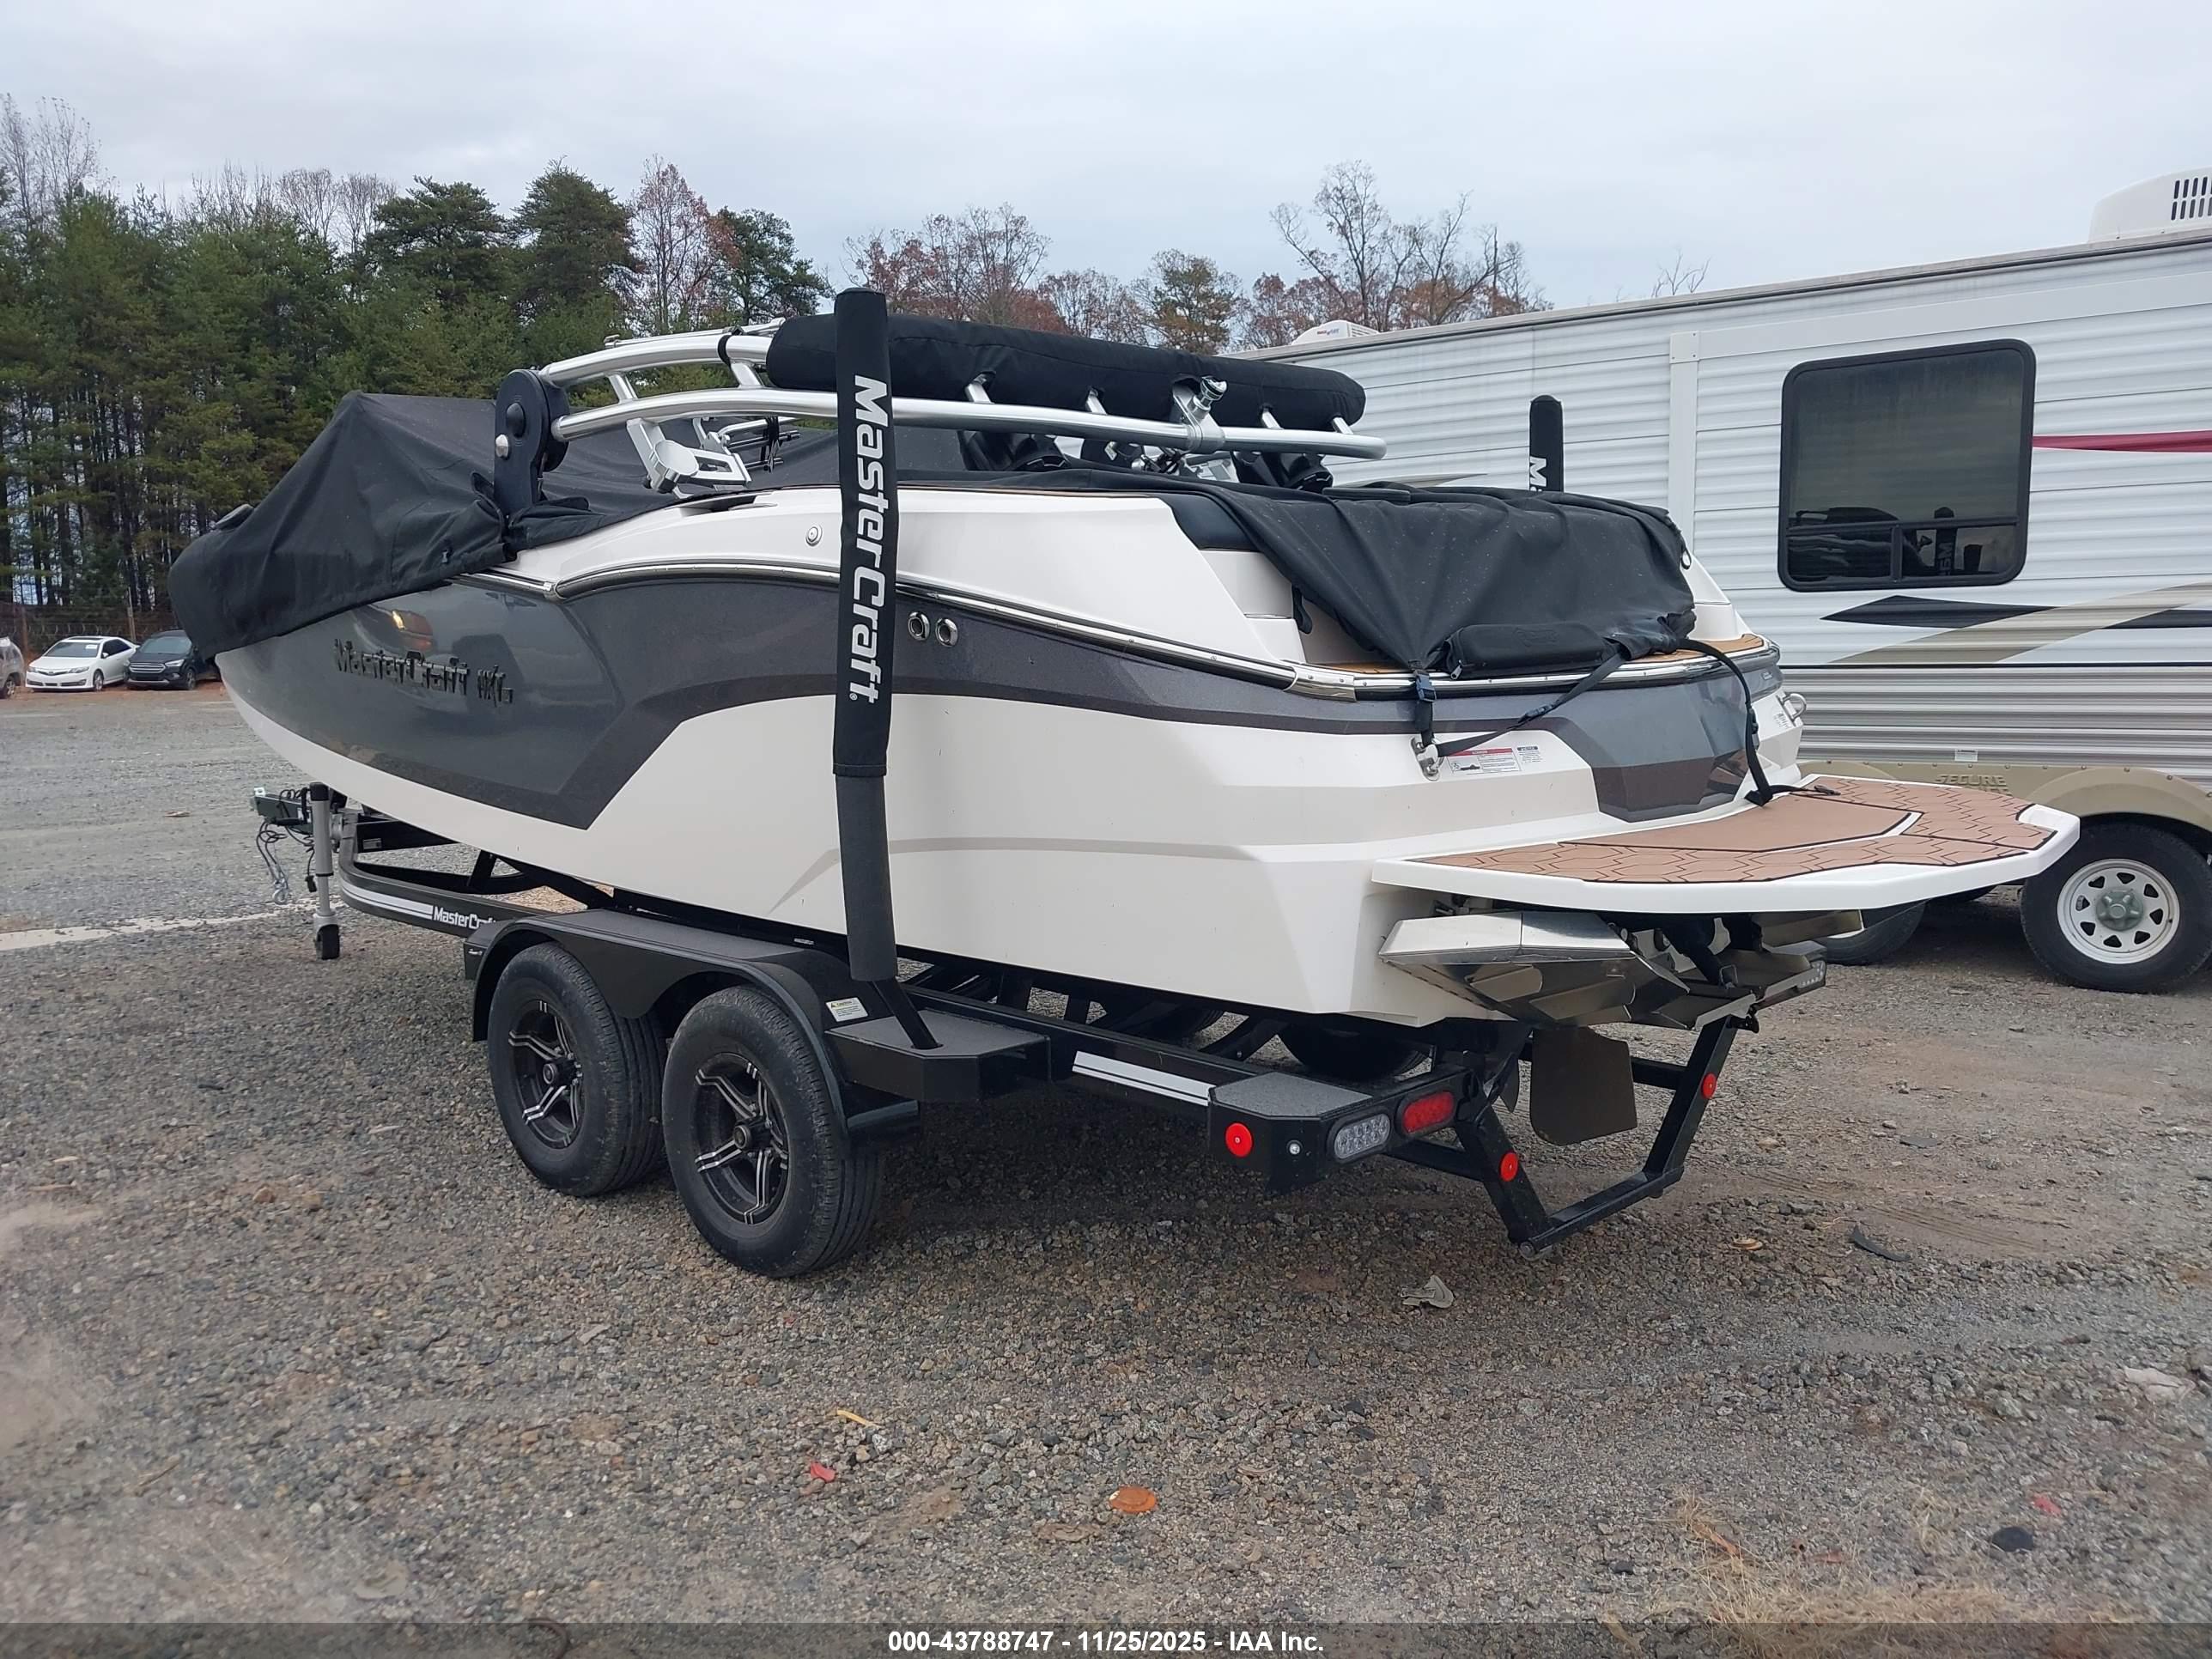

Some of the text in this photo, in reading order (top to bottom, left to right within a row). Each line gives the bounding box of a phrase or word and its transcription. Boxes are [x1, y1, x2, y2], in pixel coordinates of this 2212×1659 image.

[1529, 455, 1547, 492] M
[850, 374, 889, 704] MasterCraft
[1935, 774, 2008, 787] SECURE
[433, 905, 496, 930] MasterCr
